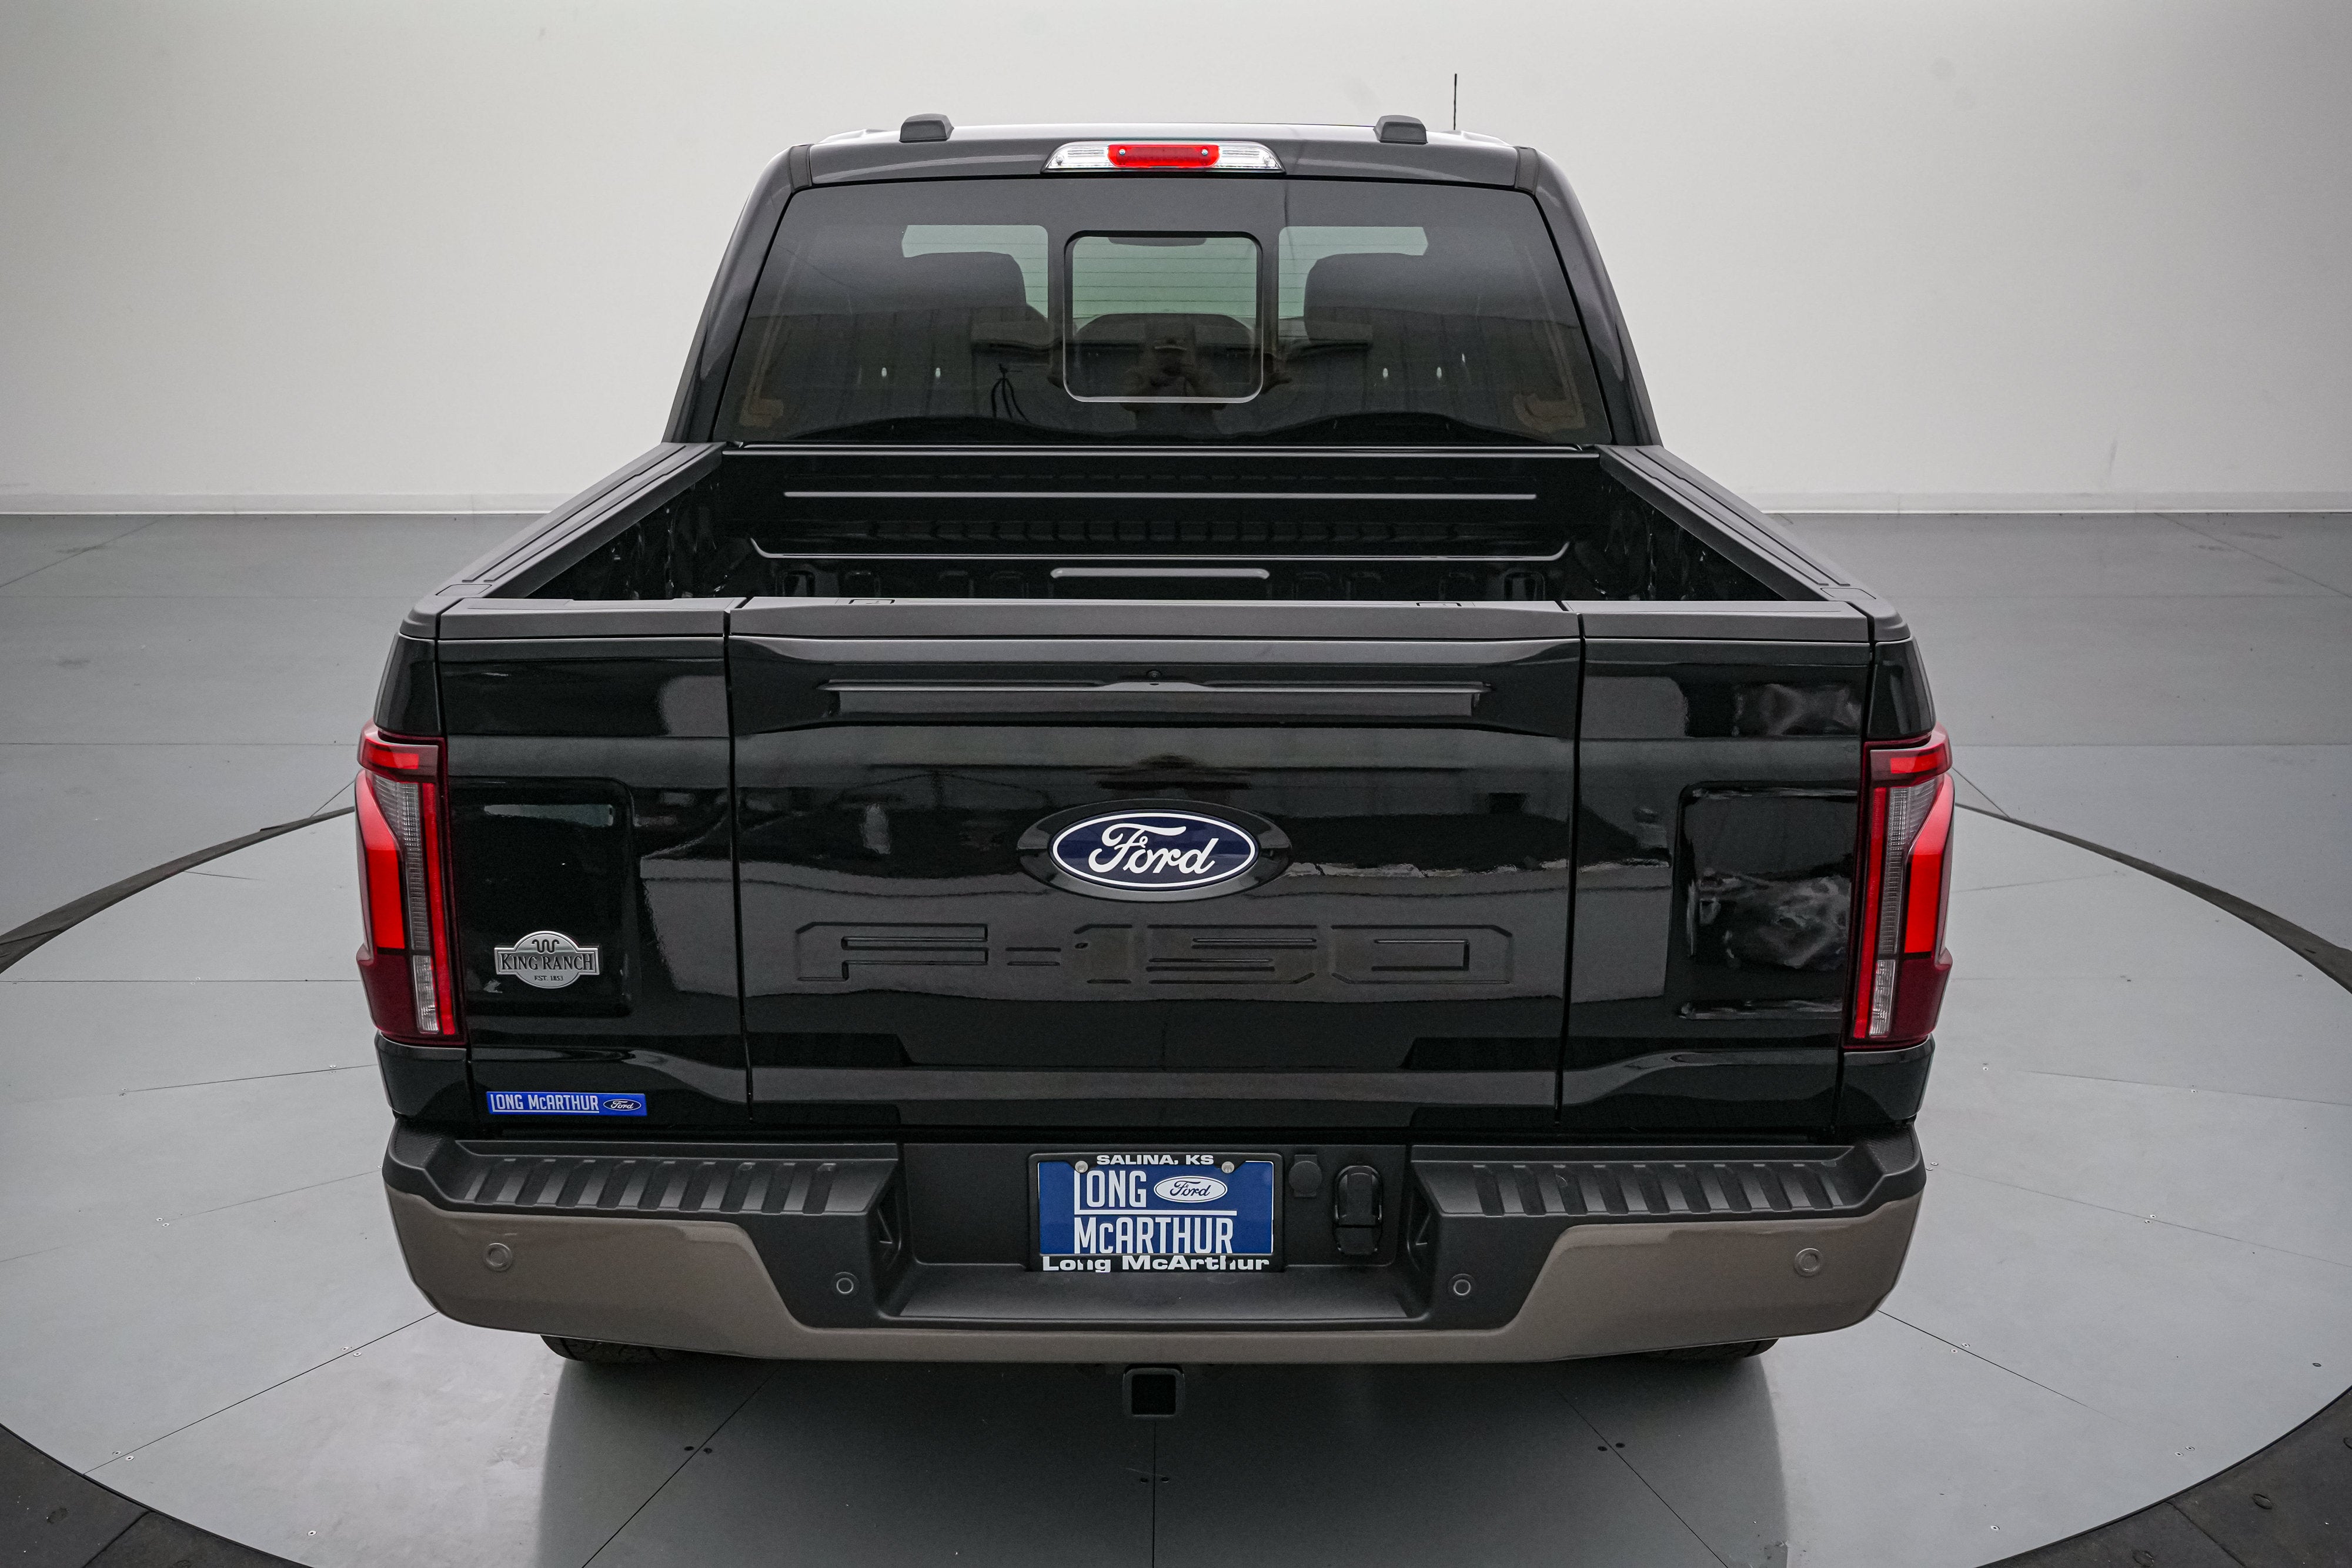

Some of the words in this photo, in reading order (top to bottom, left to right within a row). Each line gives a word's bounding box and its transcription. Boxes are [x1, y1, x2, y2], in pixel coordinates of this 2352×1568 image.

[1088, 823, 1219, 874] Ford
[500, 954, 538, 970] KING
[540, 954, 593, 971] RANCH
[490, 1094, 523, 1112] LONG
[529, 1095, 599, 1111] McARTHUR
[610, 1101, 634, 1109] Ford
[1097, 1155, 1178, 1165] SALINA,
[1185, 1155, 1214, 1165] KS
[1074, 1171, 1147, 1215] LONG
[1170, 1181, 1211, 1197] Ford
[1074, 1217, 1233, 1254] McARTHUR
[1043, 1256, 1111, 1273] Long
[1122, 1255, 1269, 1270] McArthur
